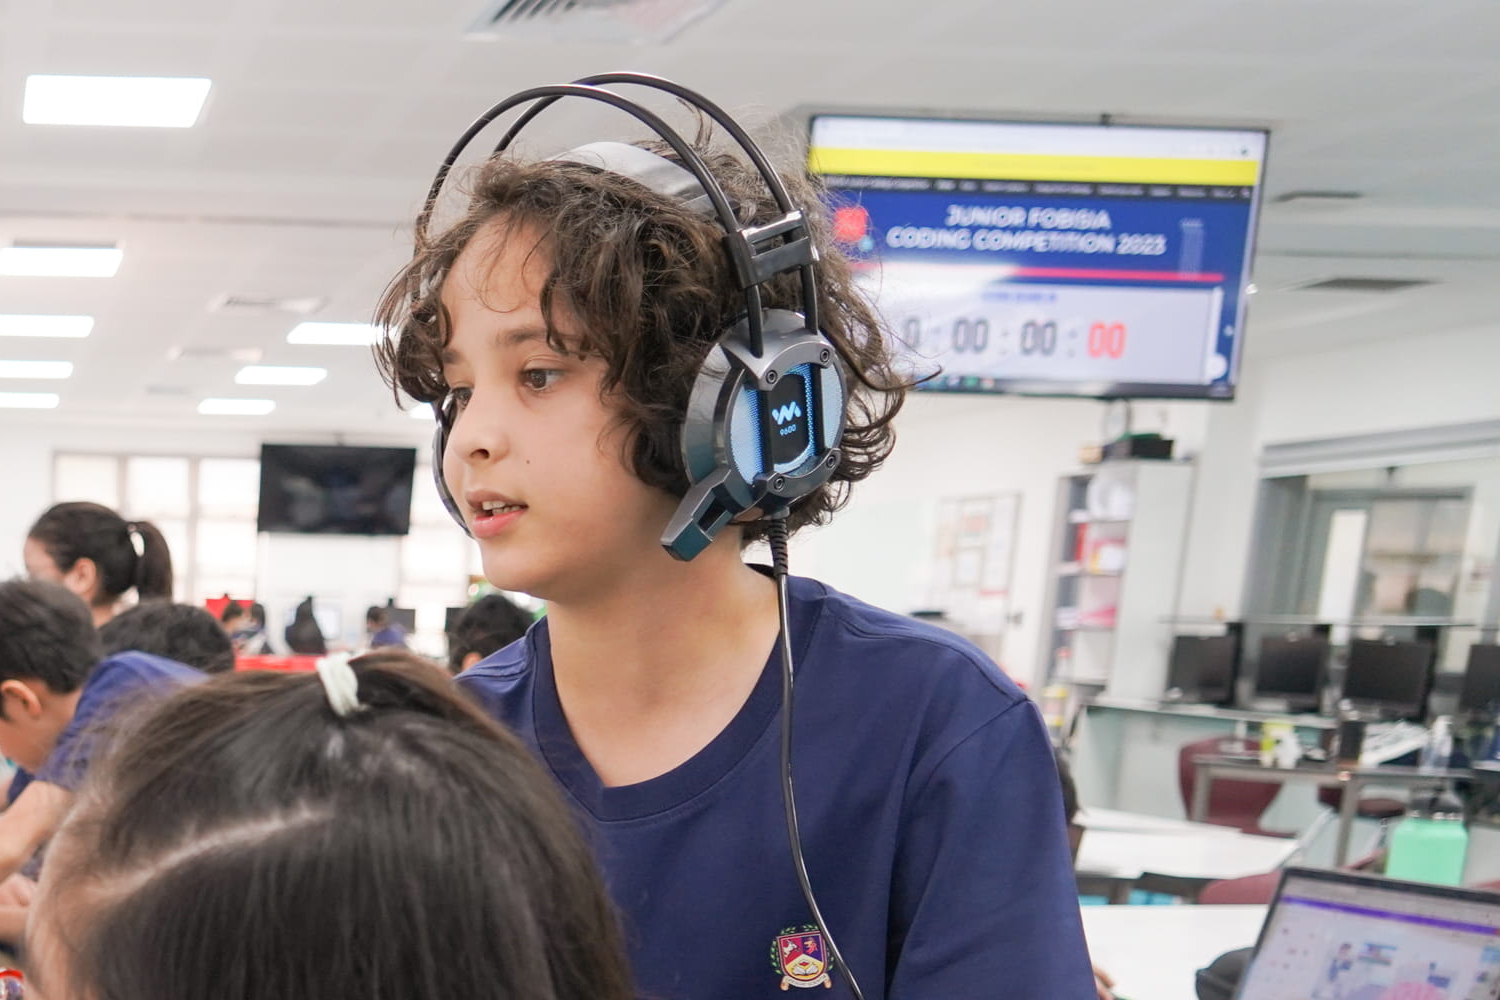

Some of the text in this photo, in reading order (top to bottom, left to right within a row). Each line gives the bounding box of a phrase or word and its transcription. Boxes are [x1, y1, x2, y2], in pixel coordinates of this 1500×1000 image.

[946, 204, 1027, 227] JUNIOR
[886, 225, 971, 249] CODING
[973, 229, 1114, 253] COMPETITION
[1087, 321, 1127, 359] 00
